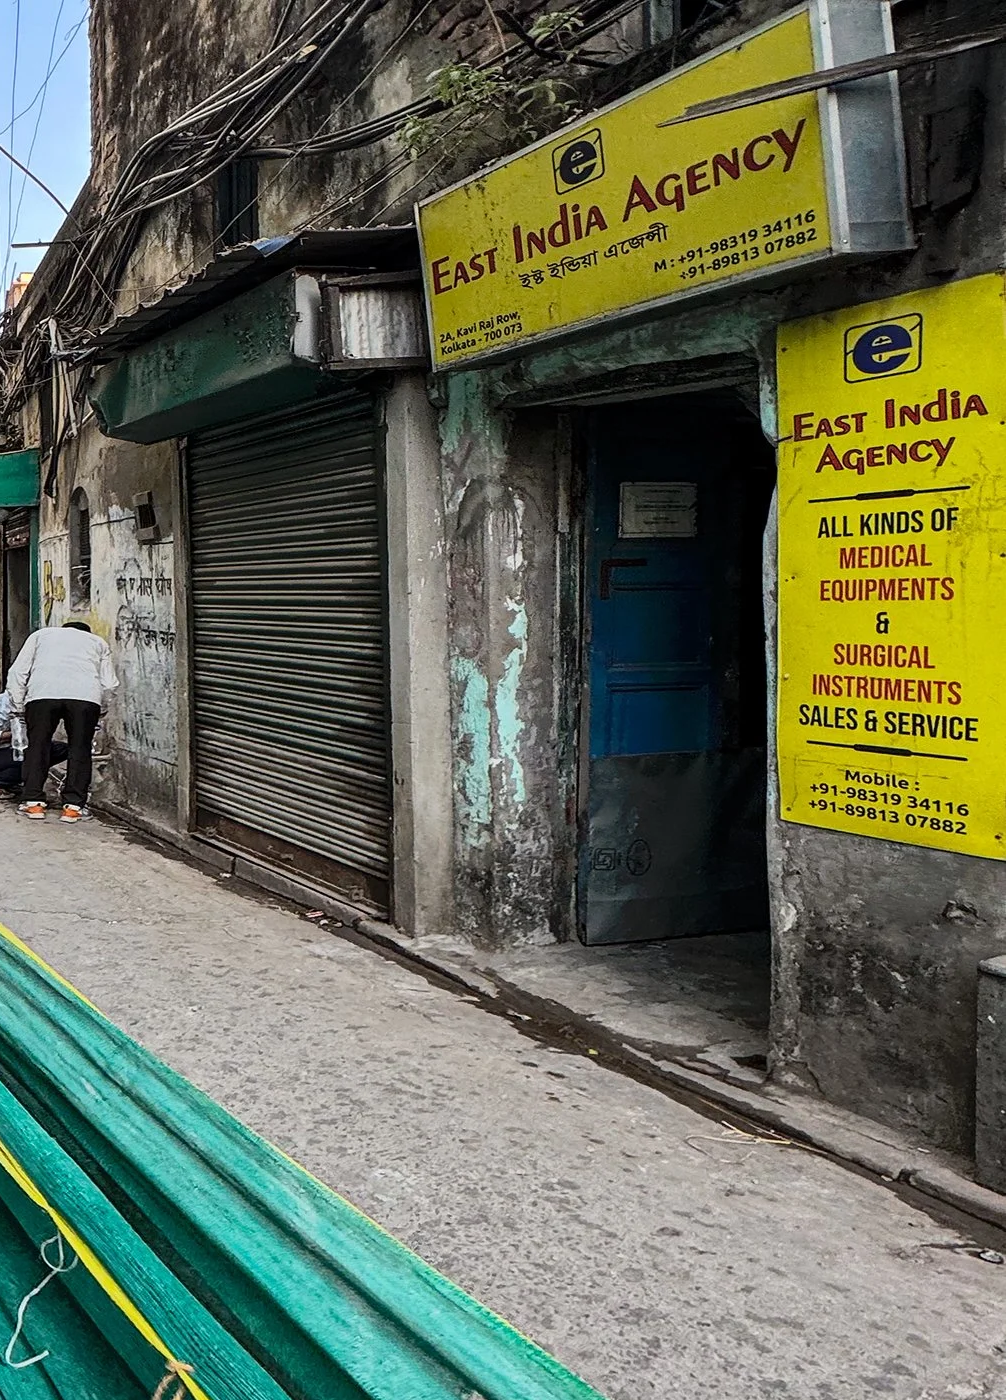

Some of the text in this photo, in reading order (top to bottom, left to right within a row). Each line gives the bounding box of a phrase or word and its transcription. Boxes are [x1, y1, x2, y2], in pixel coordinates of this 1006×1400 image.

[678, 229, 758, 263] +91-98319
[762, 209, 816, 239] 34116
[680, 228, 817, 280] +91-89813 07882
[440, 310, 521, 343] 2A, Kavi Raj Row,
[441, 338, 476, 355] Kolkata
[484, 328, 503, 343] 700
[503, 322, 523, 339] 073
[818, 507, 959, 538] ALL KINDS OF
[839, 544, 933, 570] MEDICAL
[820, 577, 955, 602] EQUIPMENTS
[876, 611, 890, 634] &
[833, 643, 936, 669] SURGICAL
[812, 673, 963, 706] INSTRUMENTS
[799, 704, 979, 742] SALES & SERVICE
[810, 782, 970, 817] +91-98319 34116
[809, 799, 968, 835] +91-89813 07882
